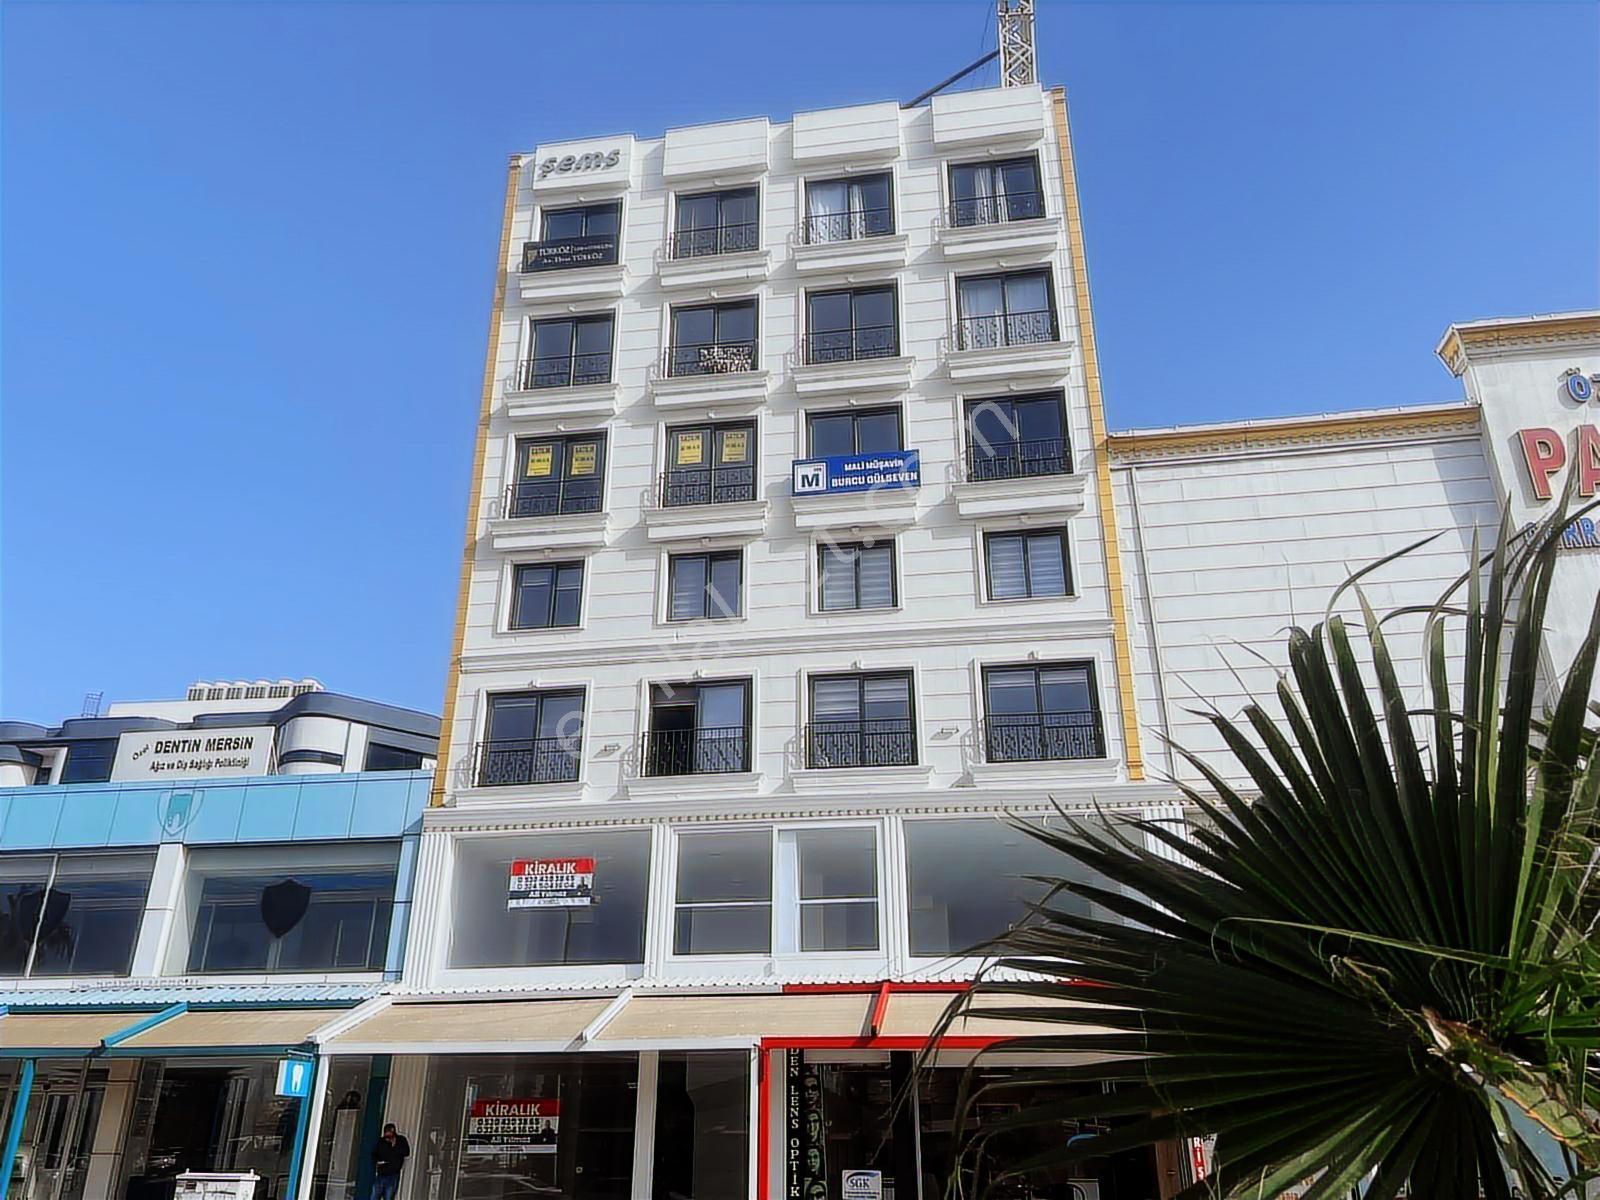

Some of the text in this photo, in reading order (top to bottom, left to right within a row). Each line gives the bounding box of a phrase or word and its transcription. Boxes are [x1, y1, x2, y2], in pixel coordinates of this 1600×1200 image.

[537, 149, 621, 178] şems
[1567, 367, 1600, 403] Ö
[831, 475, 866, 487] BURCU
[525, 860, 576, 875] KİRALIK
[485, 1100, 541, 1116] KİRALIK
[790, 1085, 800, 1129] LENS
[849, 1177, 871, 1188] SGK
